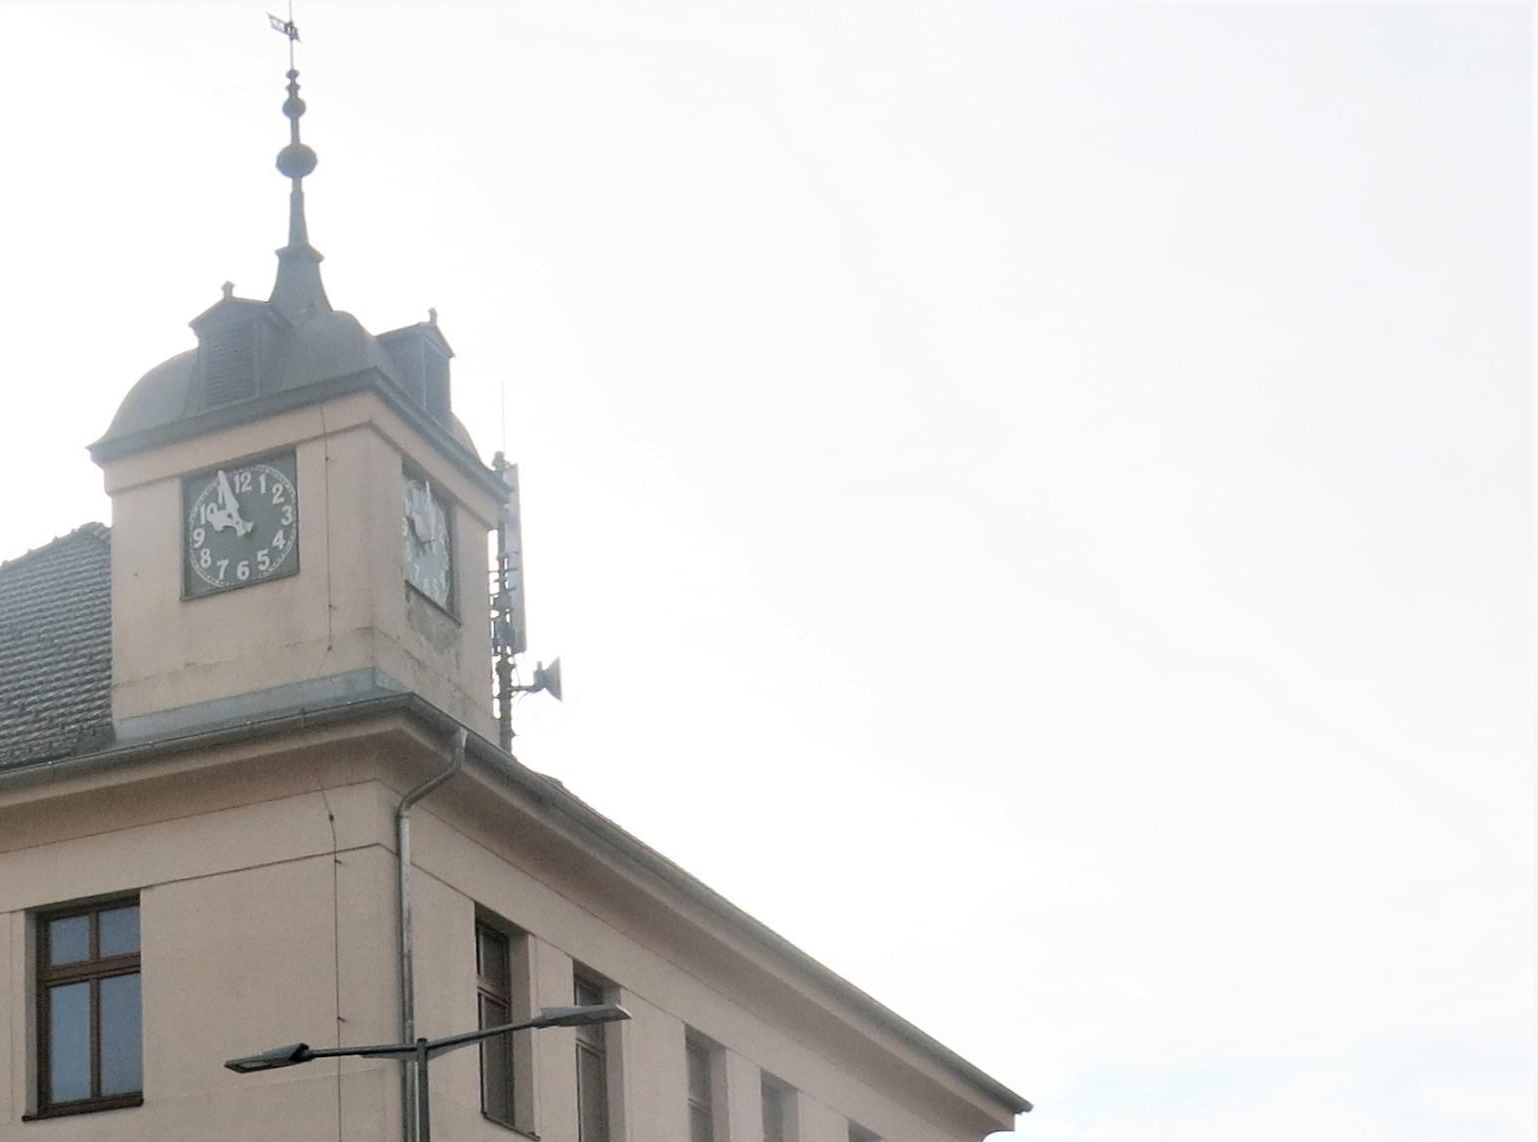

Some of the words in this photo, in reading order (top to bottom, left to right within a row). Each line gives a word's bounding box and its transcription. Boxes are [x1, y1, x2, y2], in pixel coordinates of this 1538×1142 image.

[234, 472, 252, 494] 12
[259, 473, 266, 494] 1
[272, 483, 285, 504] 2
[281, 505, 293, 525] 3
[193, 528, 205, 549] 9
[272, 529, 286, 549] 4
[200, 548, 211, 568] 8
[257, 549, 270, 570] 5
[217, 559, 229, 580] 7
[236, 561, 250, 580] 6
